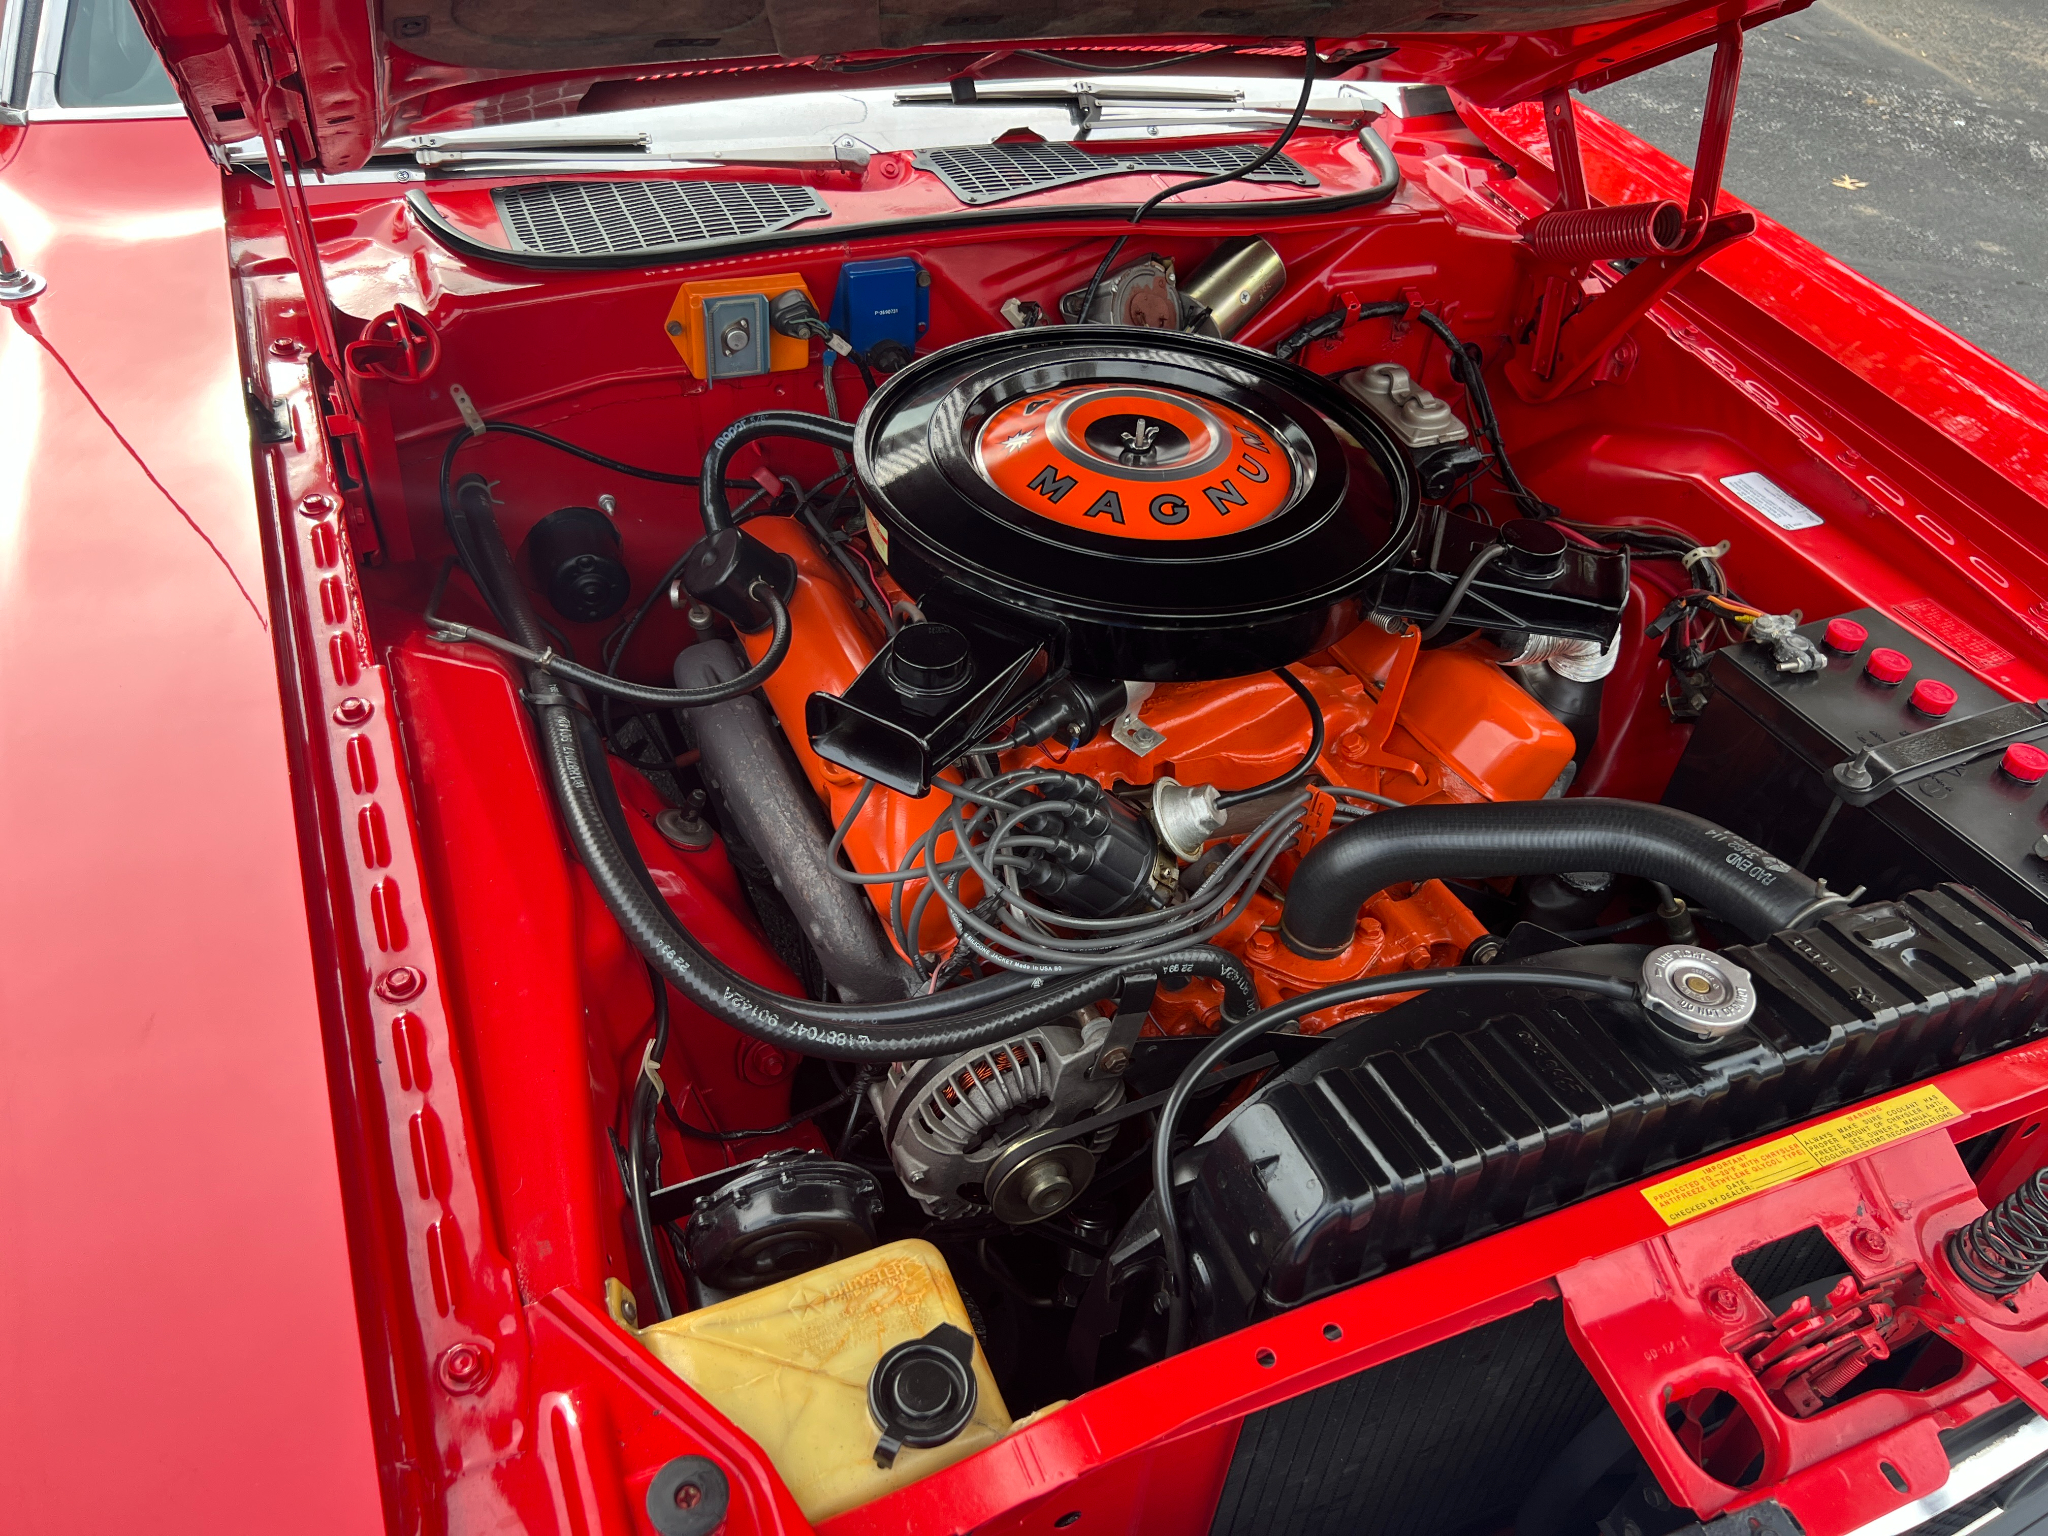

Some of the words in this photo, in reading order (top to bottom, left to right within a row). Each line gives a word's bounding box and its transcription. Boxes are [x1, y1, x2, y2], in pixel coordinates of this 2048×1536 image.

[714, 418, 747, 450] mopar
[1027, 425, 1272, 525] MAGNUM
[1725, 853, 1754, 871] END
[1749, 865, 1778, 886] RAD
[967, 935, 990, 955] SILICONE
[990, 952, 1013, 966] JACKET
[1013, 961, 1031, 970] Made
[1697, 1006, 1719, 1018] NOT
[1804, 1132, 1832, 1145] ALWAYS
[1837, 1123, 1857, 1133] MAKE
[1862, 1114, 1882, 1124] SURE
[1886, 1101, 1918, 1115] COOLANT
[1923, 1094, 1938, 1103] HAS
[1809, 1137, 1838, 1151] PROPER
[1841, 1125, 1870, 1139] AMOUNT
[1886, 1107, 1922, 1123] CHRYSLER
[1925, 1099, 1943, 1109] ANTI-
[1845, 1105, 1882, 1121] WARNING
[1848, 1135, 1864, 1144] SEE
[1867, 1123, 1899, 1137] OWNER'S
[1902, 1112, 1930, 1125] MANUAL
[1934, 1105, 1949, 1113] FOR
[1819, 1147, 1853, 1162] COOLING
[1853, 1135, 1885, 1150] SYSTEMS
[1886, 1110, 1955, 1138] RECOMMENDATIONS.
[1653, 1179, 1702, 1201] PROTECTED
[1740, 1158, 1758, 1168] WITH
[1760, 1143, 1799, 1161] CHRYSLER
[1658, 1185, 1706, 1207] ANTIFREEZE
[1708, 1169, 1749, 1189] (ETHYLENE
[1751, 1157, 1781, 1172] GLYCOL
[1782, 1148, 1806, 1160] TYPE)
[1702, 1154, 1747, 1174] IMPORTANT
[1726, 1179, 1746, 1190] DATE
[1669, 1201, 1706, 1218] CHECKED
[825, 1261, 905, 1298] CHRYSLER
